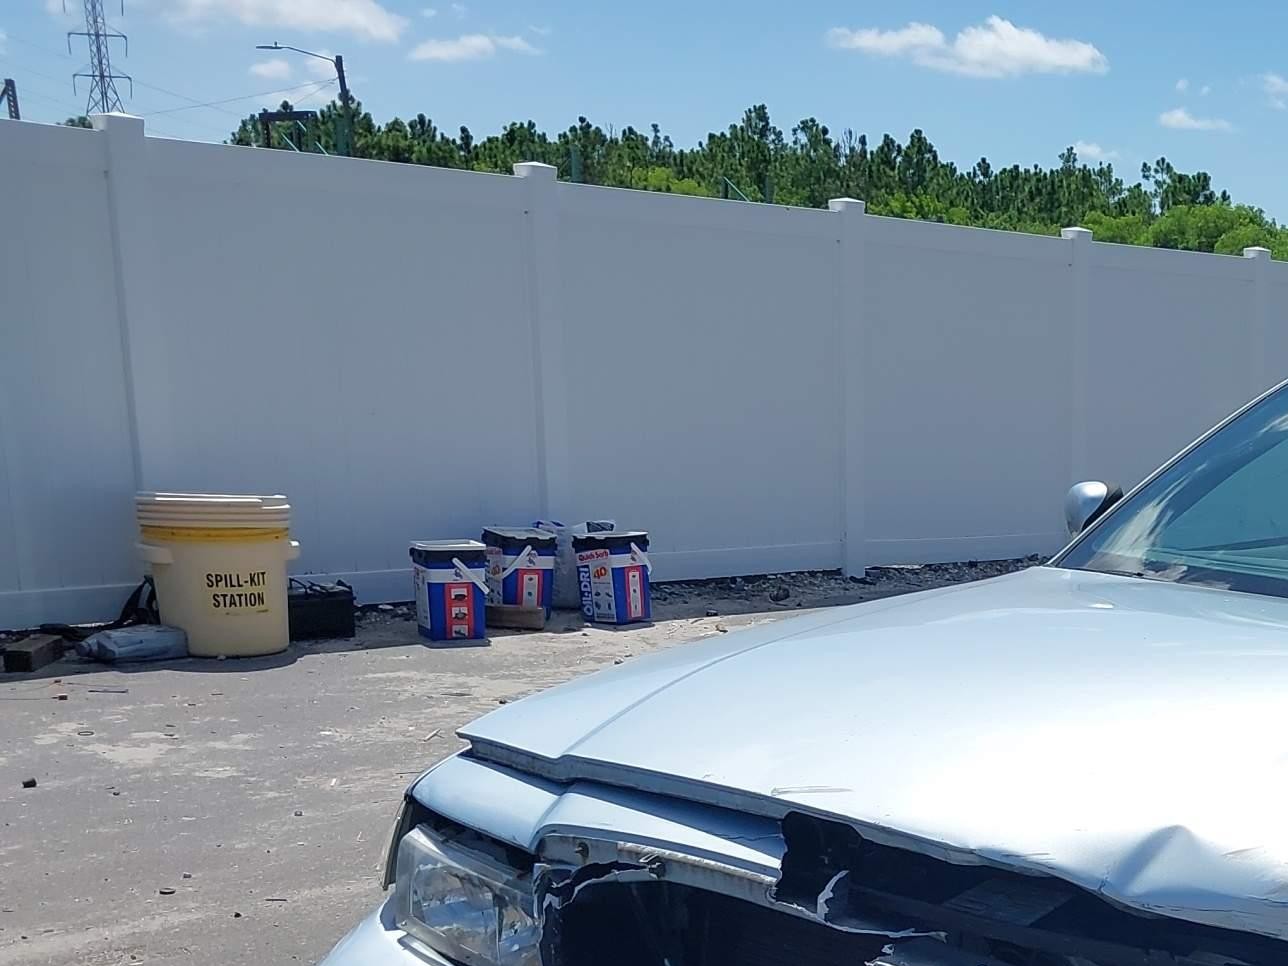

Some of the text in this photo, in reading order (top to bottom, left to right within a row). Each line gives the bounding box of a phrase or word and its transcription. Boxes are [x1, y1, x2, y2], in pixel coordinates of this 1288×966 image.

[206, 572, 266, 588] SPILL-KIT
[593, 566, 607, 580] 40
[212, 592, 265, 608] STATION
